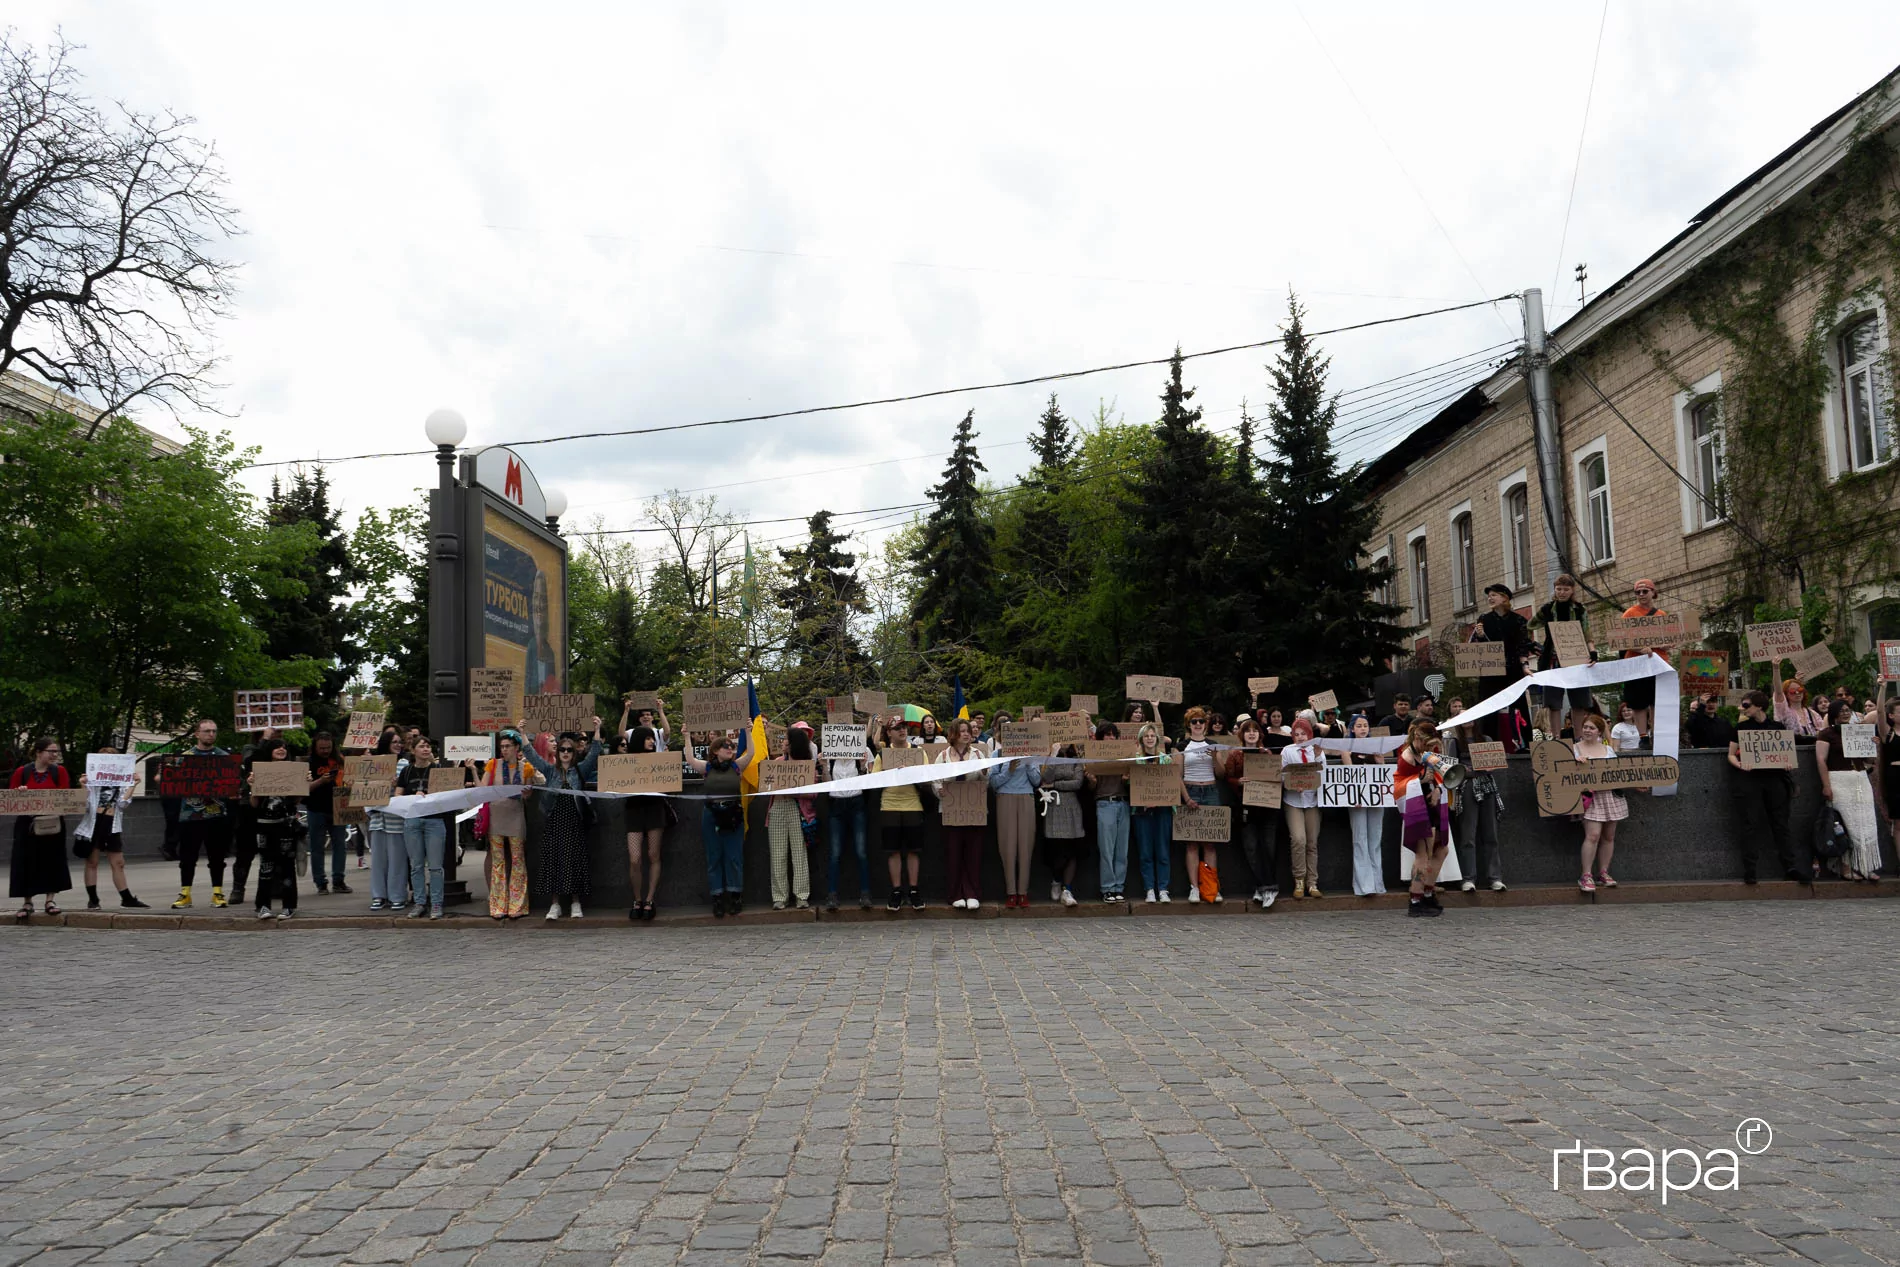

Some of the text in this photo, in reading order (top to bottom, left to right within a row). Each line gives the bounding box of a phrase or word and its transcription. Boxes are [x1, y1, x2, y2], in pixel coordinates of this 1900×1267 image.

[505, 454, 523, 506] М
[486, 578, 529, 620] ТУРБОТА
[1761, 634, 1796, 646] КРАДЕ
[1486, 643, 1504, 653] USSR
[1776, 644, 1803, 655] ПРАВА
[1456, 660, 1470, 669] NOT
[351, 712, 383, 723] ВИ ТАМ
[525, 706, 596, 720] ЗАЛИШТЕ ДЛЯ
[357, 722, 373, 730] ШО
[540, 718, 584, 732] СУСІДІВ
[823, 734, 862, 748] ЗЕМЕЛЬ
[602, 757, 640, 768] РУСЛАНЕ
[1754, 751, 1761, 763] В
[163, 767, 218, 780] СИСТЕМА
[767, 764, 810, 774] ЗУПИНИТИ
[1326, 766, 1367, 783] НОВИЙ
[1372, 767, 1391, 784] ЦК
[607, 778, 636, 789] ДАВАЙ
[652, 775, 679, 785] НОВОЙ
[764, 775, 806, 787] #15150
[1561, 765, 1677, 787] МІРИЛО ДОБРОЗВИЧАЙНОСТІ
[161, 781, 211, 796] ПРАЦЮЄ
[362, 785, 390, 801] БОЛОТА
[943, 781, 987, 807] STOP
[1177, 816, 1206, 829] ТАКОЖ
[1184, 829, 1191, 839] З
[1195, 827, 1229, 840] ПРАВАМИ
